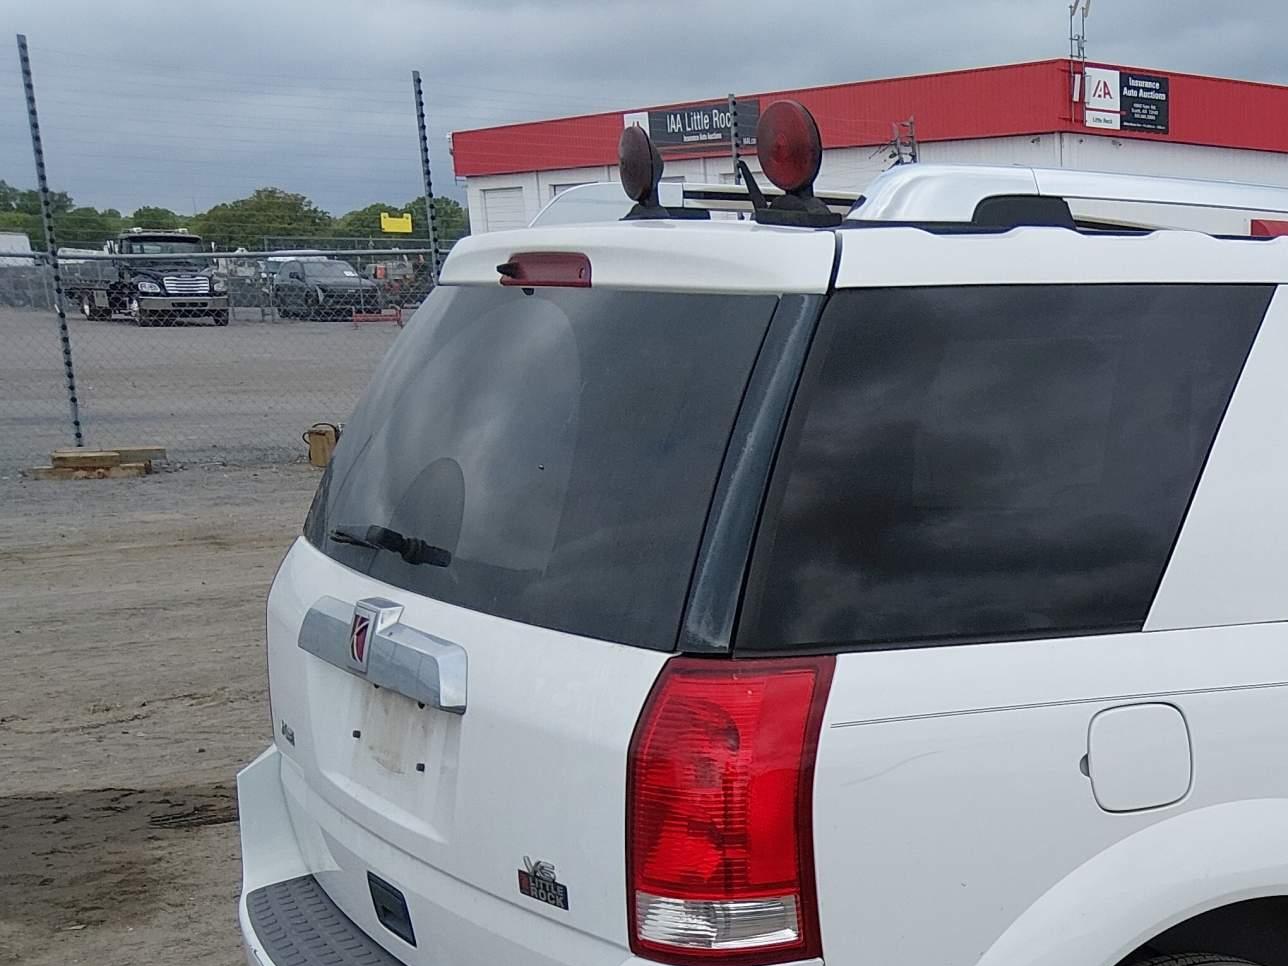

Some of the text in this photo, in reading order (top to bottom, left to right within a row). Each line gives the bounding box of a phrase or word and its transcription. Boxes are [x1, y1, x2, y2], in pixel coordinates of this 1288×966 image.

[1123, 87, 1166, 100] Auto Auctions
[1129, 77, 1160, 90] Insurance
[666, 109, 732, 133] IAA Little Roc
[523, 856, 557, 882] V6
[529, 875, 564, 896] LITTLE
[530, 886, 565, 908] ROCK
